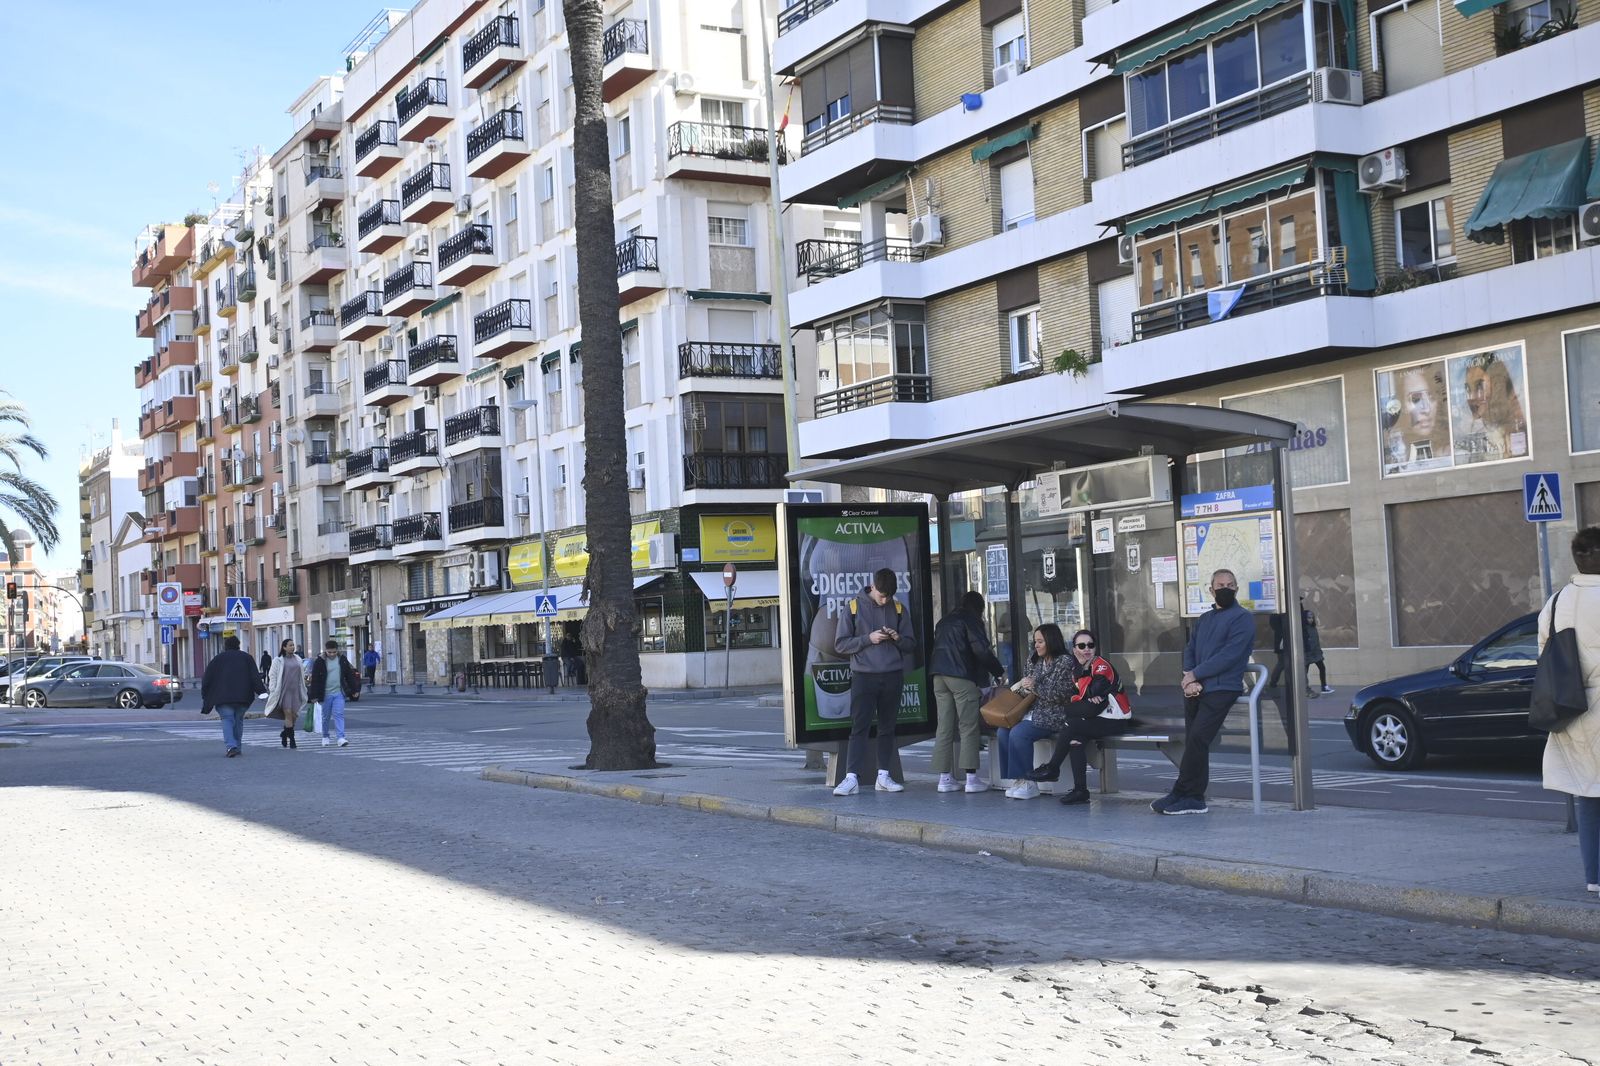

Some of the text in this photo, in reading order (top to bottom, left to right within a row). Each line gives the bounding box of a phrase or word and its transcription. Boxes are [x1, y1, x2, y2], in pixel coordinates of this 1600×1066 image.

[1215, 490, 1236, 501] ZAFRA
[1214, 503, 1219, 512] 8
[835, 522, 884, 535] ACTIVIA
[811, 571, 912, 596] ¿DIGESTIES
[816, 668, 854, 682] ACTIVIA
